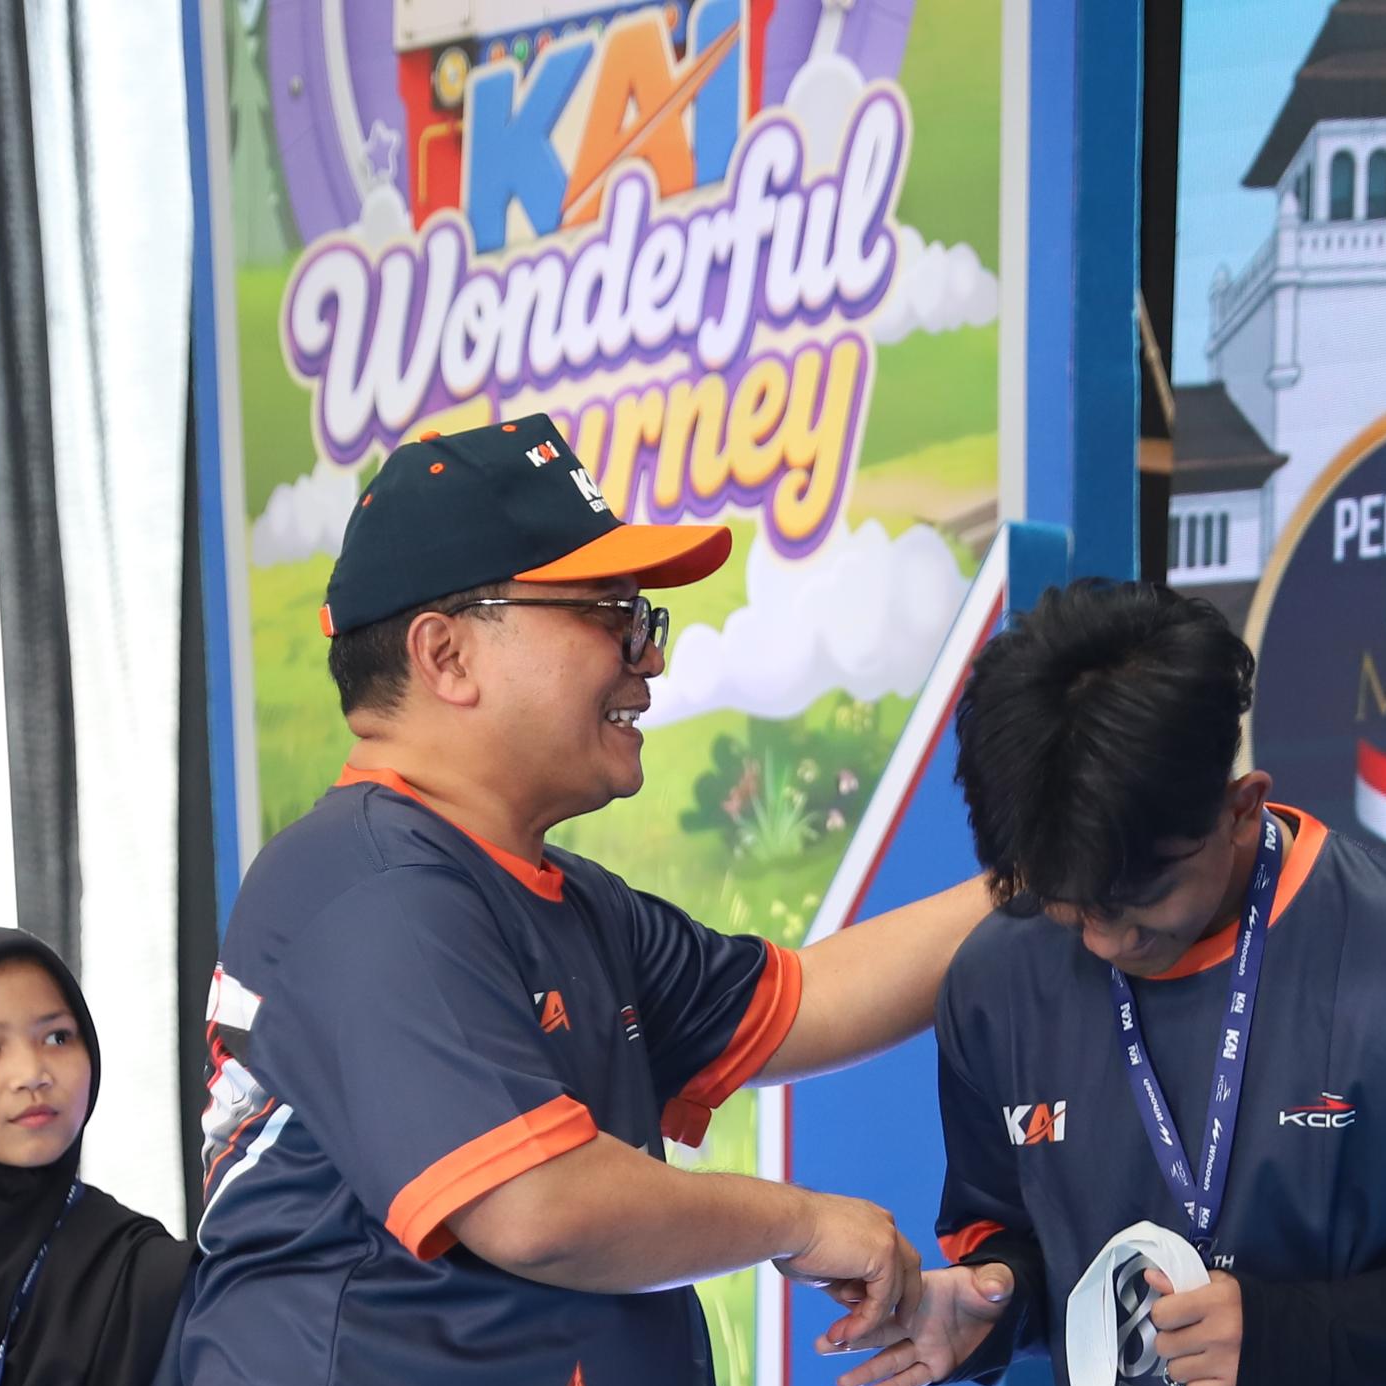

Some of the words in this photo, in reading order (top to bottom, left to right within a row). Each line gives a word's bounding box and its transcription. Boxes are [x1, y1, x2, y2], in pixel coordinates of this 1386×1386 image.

[467, 0, 744, 252] KAI
[290, 90, 899, 445] Wonderful
[525, 440, 561, 467] KAI
[1264, 821, 1277, 851] KAI
[1238, 930, 1252, 977] Whoosh
[1120, 1002, 1133, 1031] KAI
[1222, 1029, 1240, 1060] KAI
[1143, 1078, 1164, 1122] Whoosh
[1278, 1110, 1356, 1129] KCIC
[1002, 1100, 1067, 1145] KAI
[1204, 1144, 1217, 1192] Whoosh
